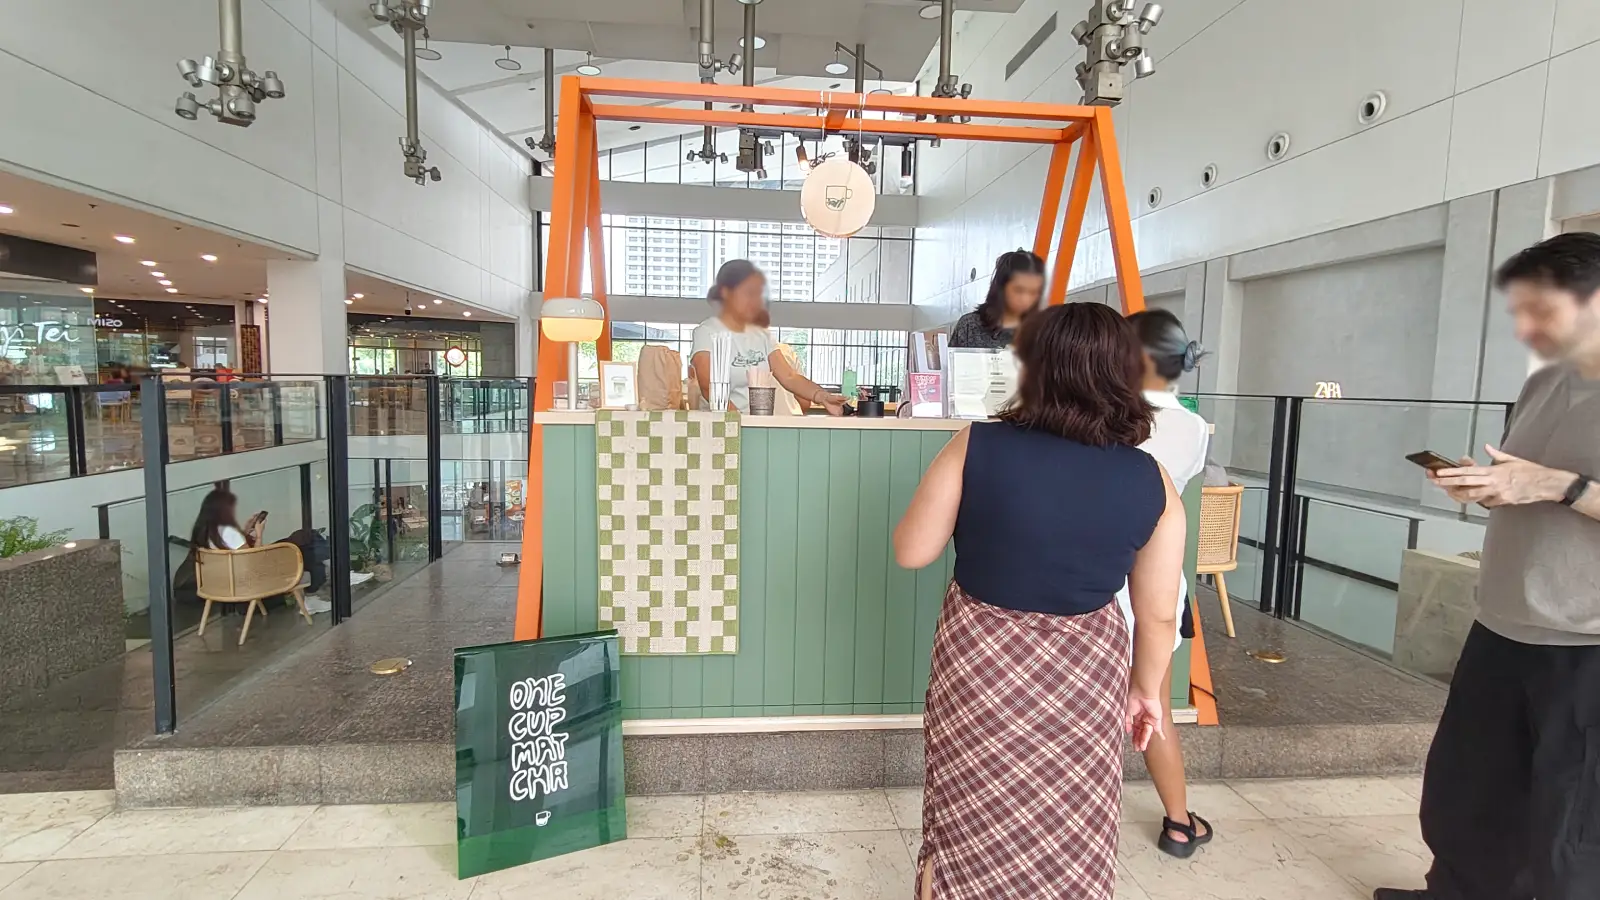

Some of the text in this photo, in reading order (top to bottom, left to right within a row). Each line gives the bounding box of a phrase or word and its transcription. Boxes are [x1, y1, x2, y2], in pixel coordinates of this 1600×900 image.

[32, 321, 80, 344] Tei
[1314, 381, 1342, 398] ZARA
[509, 673, 566, 710] ONE
[508, 708, 566, 741] CUP
[511, 733, 569, 771] MAT
[509, 761, 569, 801] CHA
